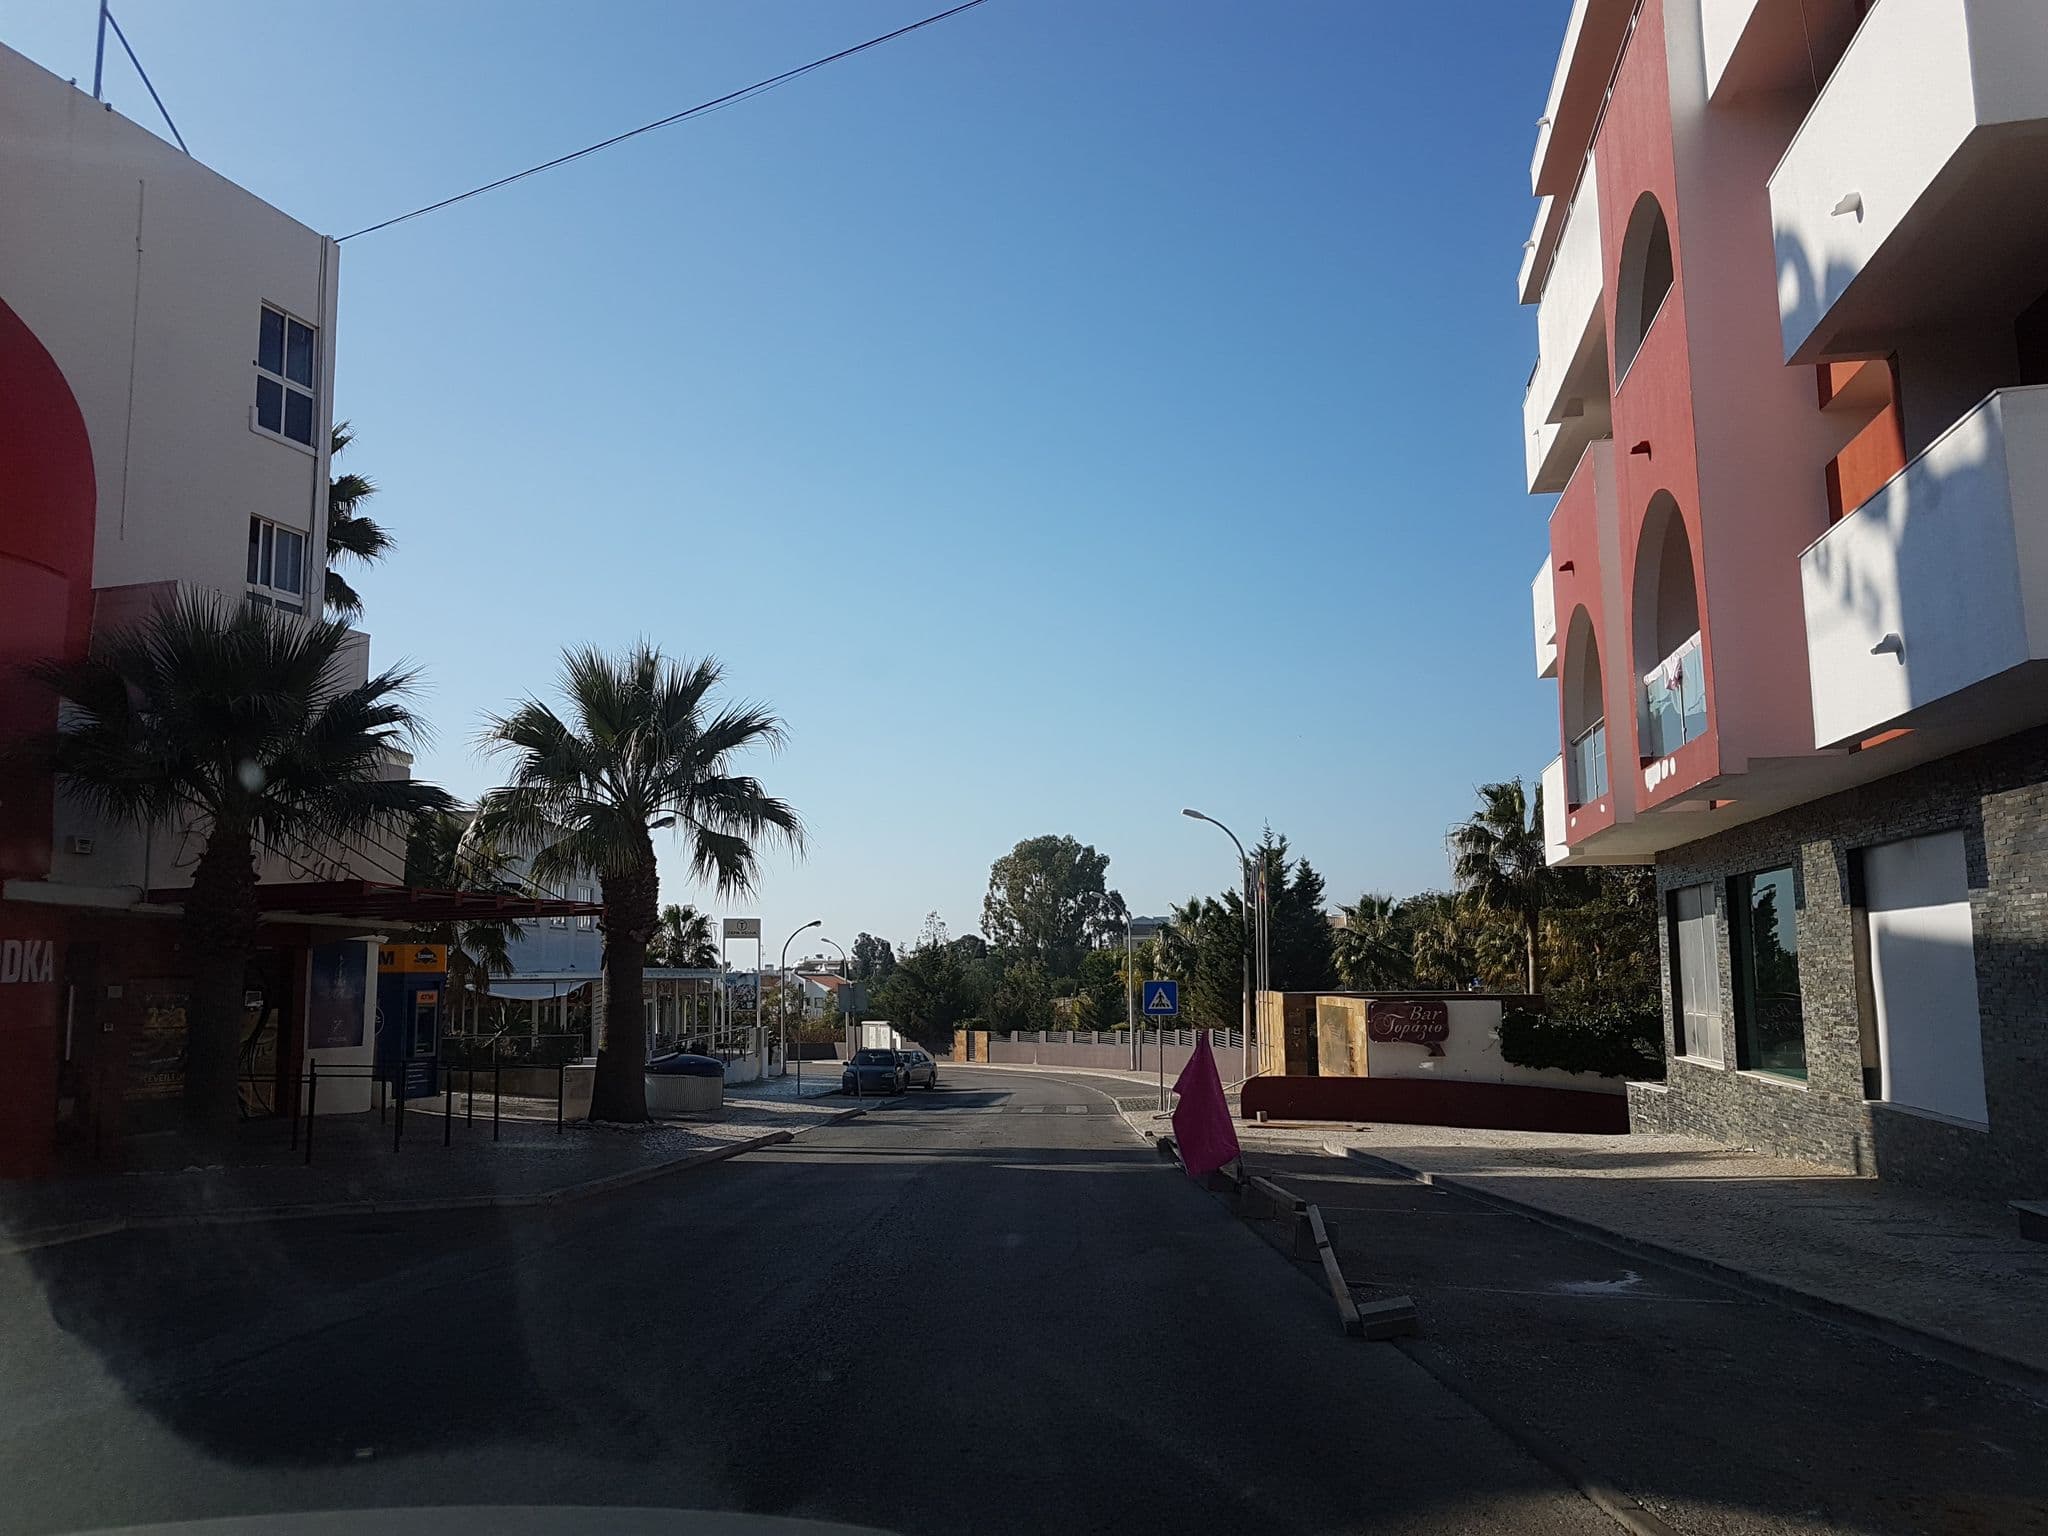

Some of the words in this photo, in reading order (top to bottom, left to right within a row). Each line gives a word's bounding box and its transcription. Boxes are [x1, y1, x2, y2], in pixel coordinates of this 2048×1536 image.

[0, 940, 55, 983] DKA
[420, 993, 434, 1001] ATM
[1409, 1006, 1443, 1021] Bar
